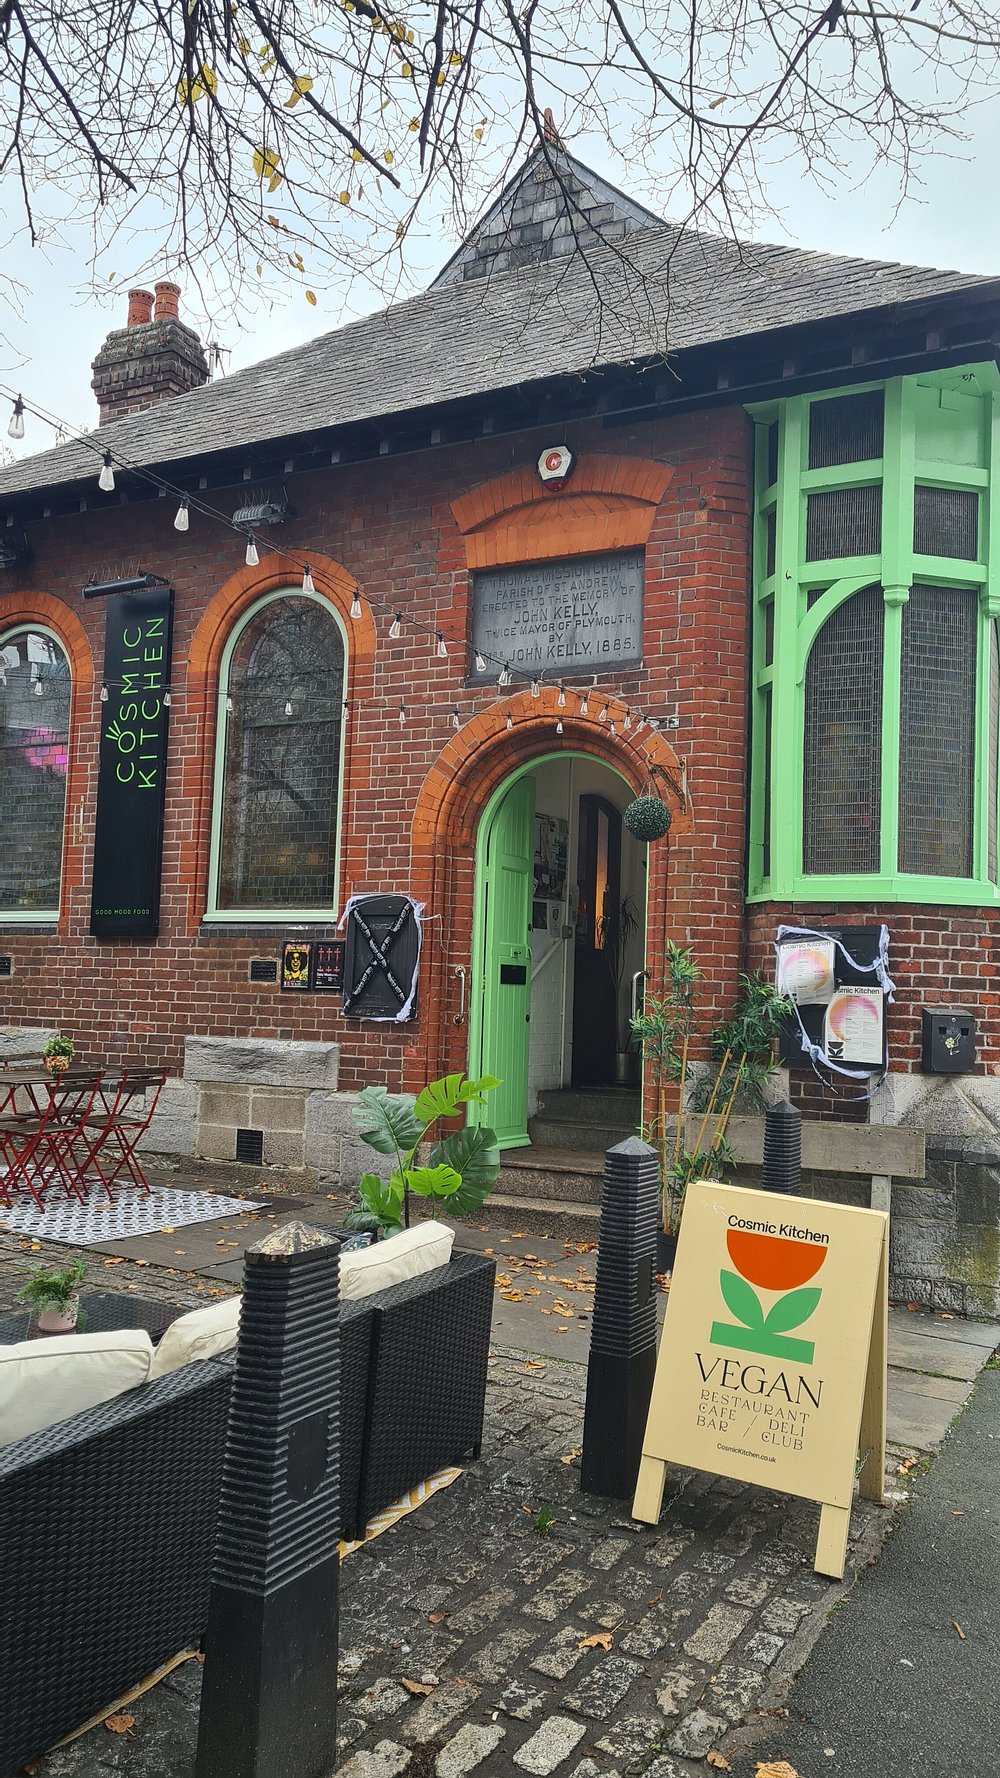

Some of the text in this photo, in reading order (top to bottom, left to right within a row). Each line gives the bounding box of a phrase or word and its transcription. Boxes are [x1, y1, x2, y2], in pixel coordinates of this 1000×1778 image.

[490, 571, 539, 588] THOMAS
[542, 563, 590, 581] MISSION
[593, 558, 643, 575] CHAPEL
[482, 585, 636, 612] ERECTED TO THE MEMORY OF
[496, 586, 534, 600] PARISH
[537, 583, 551, 595] OF
[514, 608, 548, 623] JOHN
[485, 627, 517, 639] TWICE
[520, 623, 555, 635] MAYOR
[558, 621, 572, 631] OF
[549, 632, 563, 643] BY
[508, 647, 542, 661] JOHN
[114, 626, 142, 783] COSMIC
[138, 617, 164, 788] KITCHEN
[855, 987, 880, 995] Kitchen
[728, 1214, 830, 1244] Cosmic Kitchen
[695, 1352, 824, 1409] VEGAN
[698, 1402, 737, 1421] CAFE
[768, 1418, 805, 1438] DELI
[700, 1389, 810, 1424] RESTAURANT
[696, 1415, 729, 1433] BAR
[761, 1431, 803, 1451] CLUB
[716, 1442, 777, 1464] CosmicKitchen.co.uk
